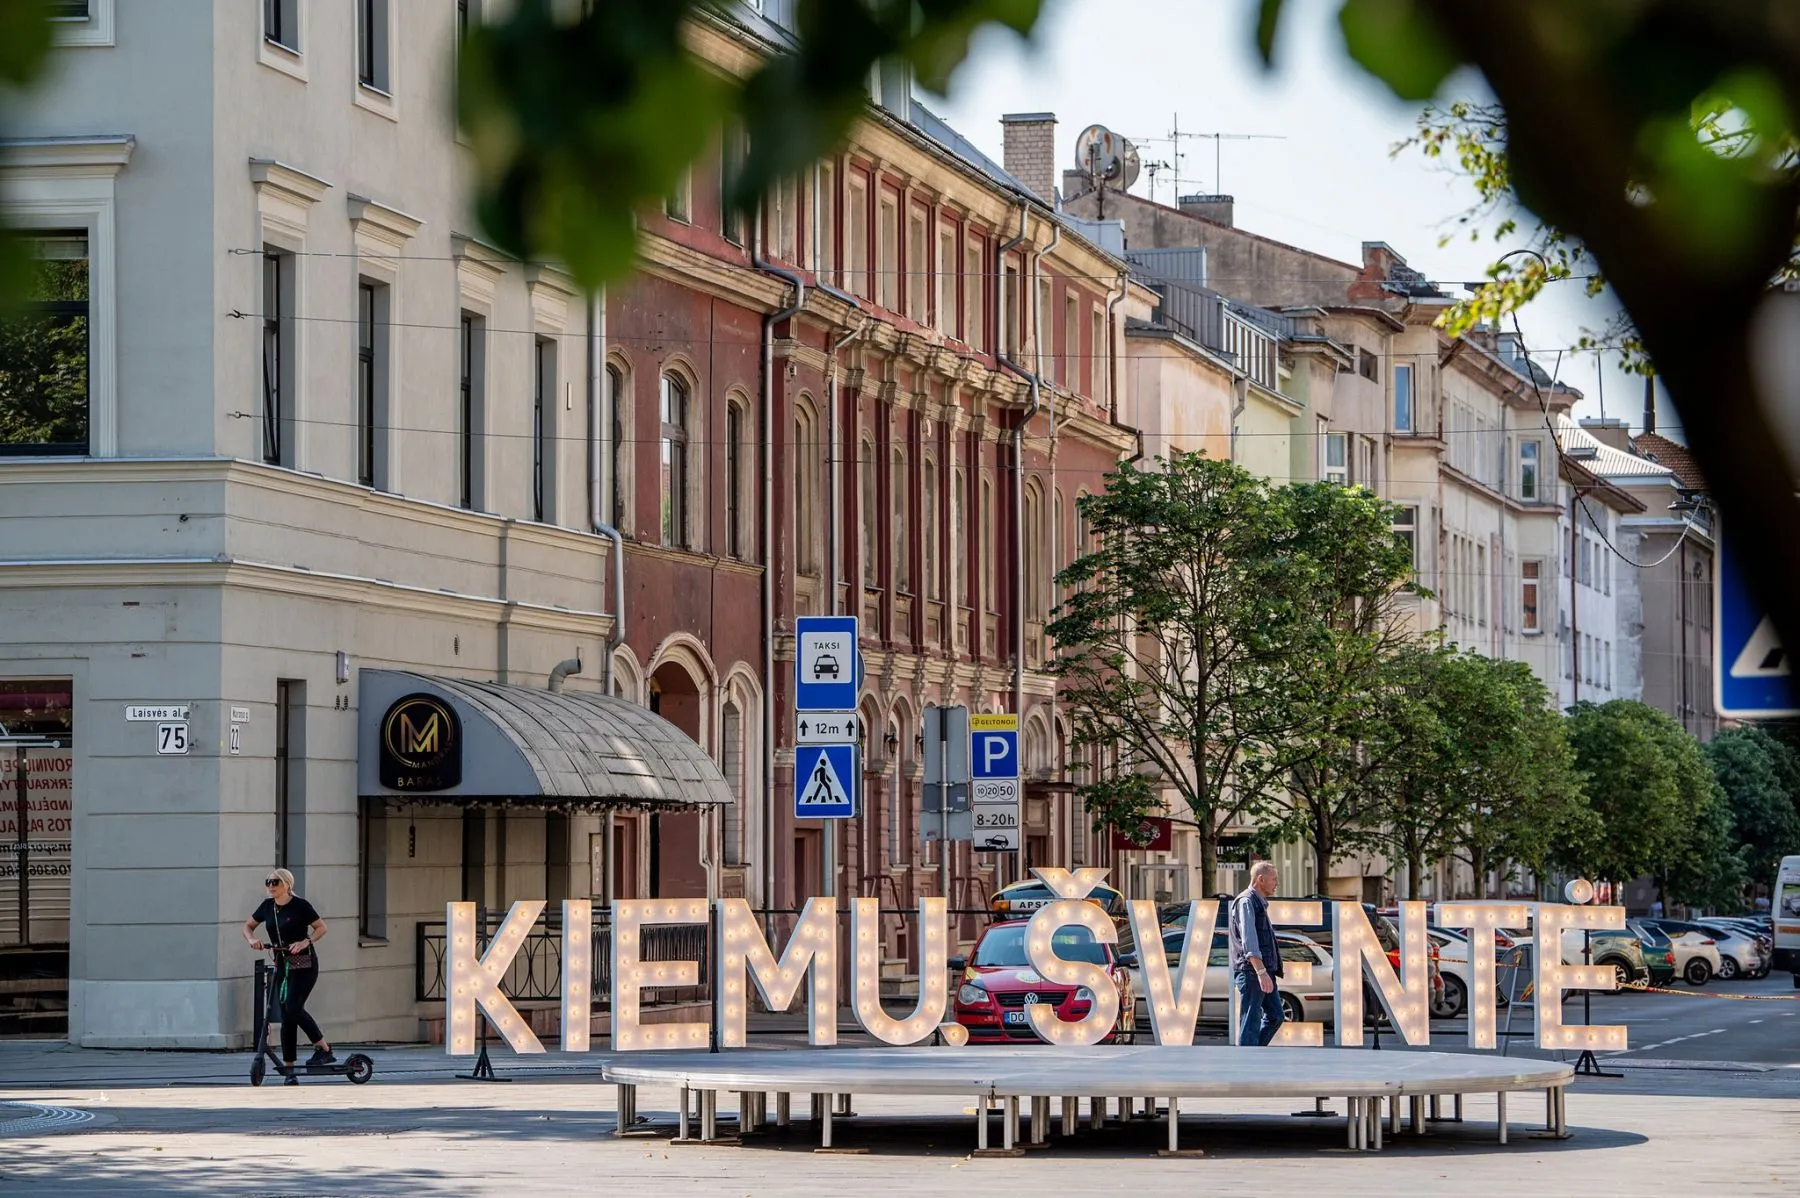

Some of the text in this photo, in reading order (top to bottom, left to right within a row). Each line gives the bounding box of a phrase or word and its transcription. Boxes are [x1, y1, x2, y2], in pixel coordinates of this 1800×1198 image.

[814, 642, 840, 650] TAKSI
[132, 708, 182, 718] Laisvės al.
[980, 718, 1016, 726] GELTONOJI
[161, 727, 185, 750] 75
[231, 728, 239, 750] 22
[984, 736, 1010, 773] P
[977, 785, 1013, 796] 10 20 50
[1023, 866, 1629, 1051] ŠVENTĖ
